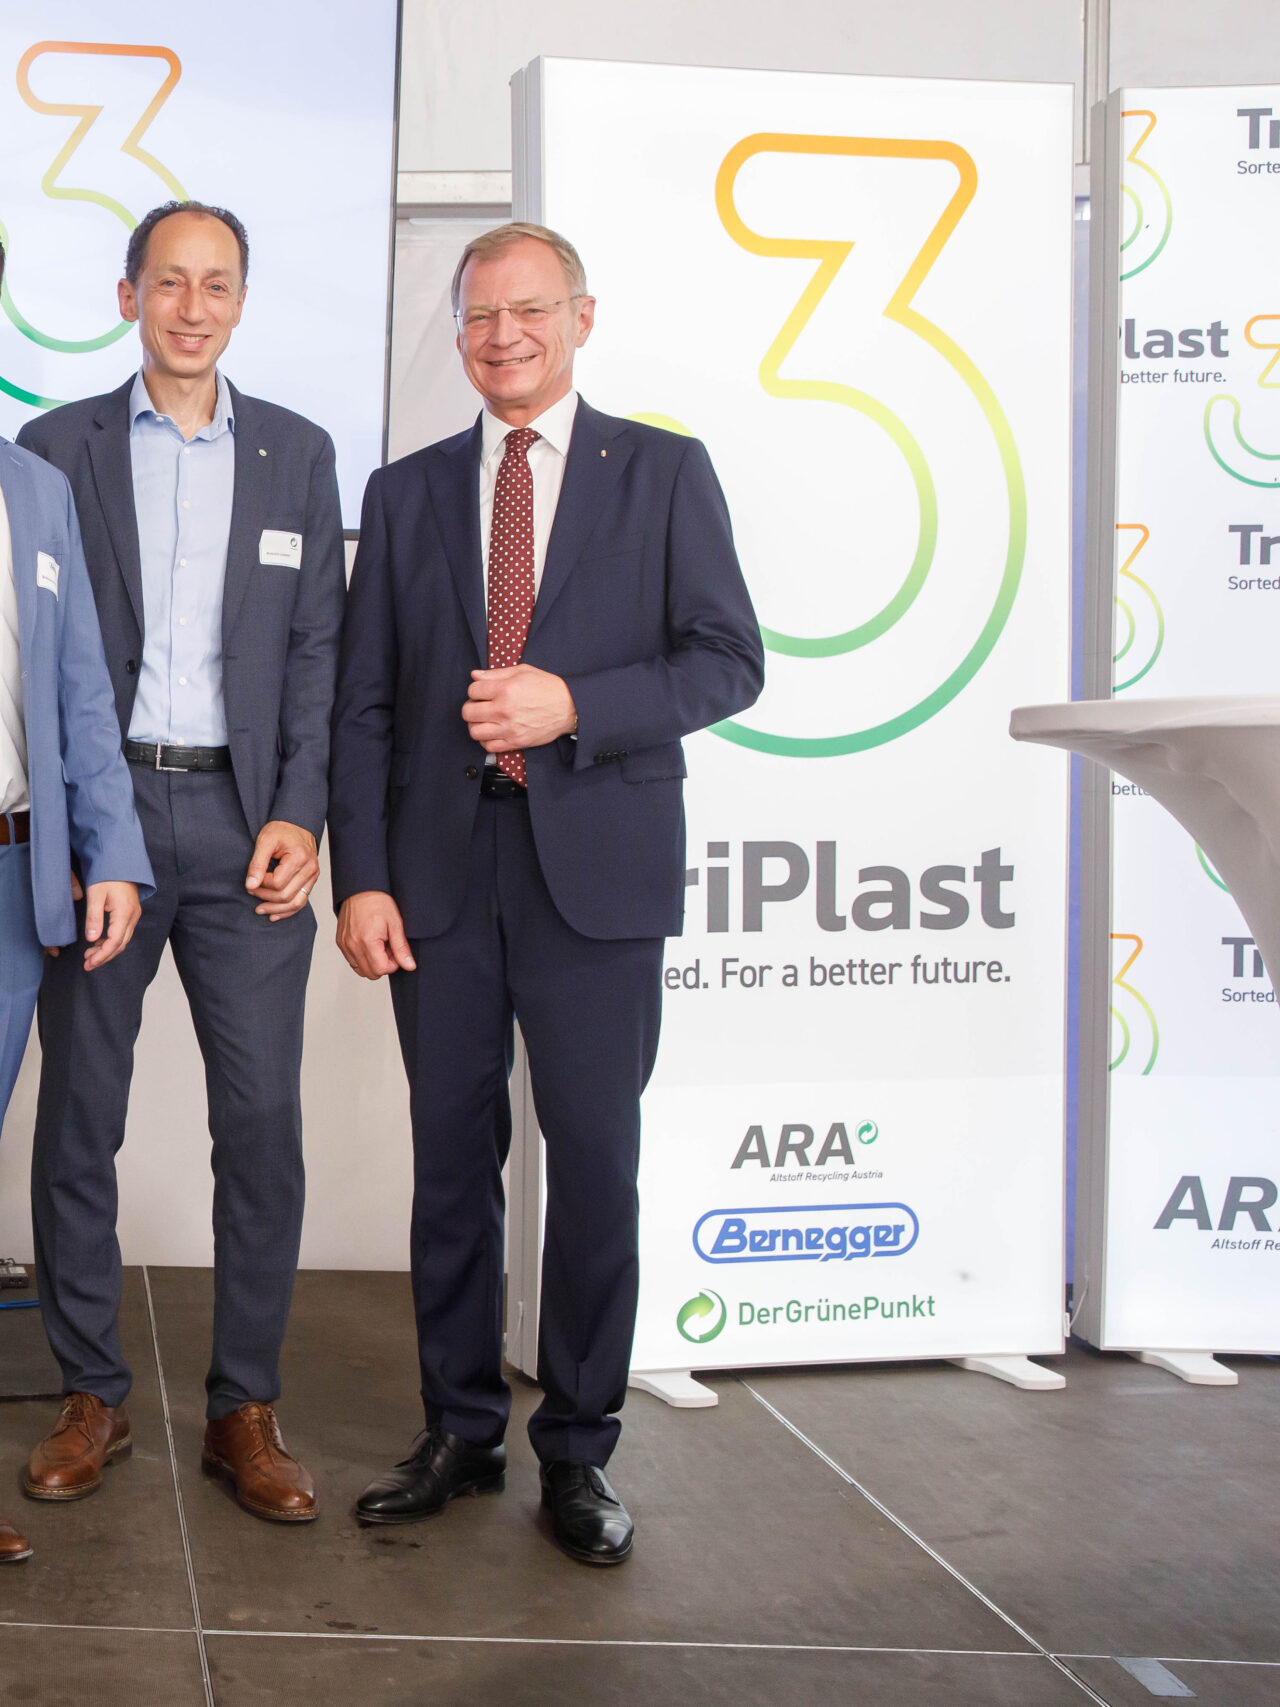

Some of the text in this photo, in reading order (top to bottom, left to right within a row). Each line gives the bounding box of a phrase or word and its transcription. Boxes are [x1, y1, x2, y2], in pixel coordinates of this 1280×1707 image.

[1118, 318, 1230, 360] last
[1120, 369, 1227, 384] better future.
[1111, 780, 1151, 796] bett
[721, 957, 773, 989] For
[781, 963, 799, 987] a
[809, 956, 903, 987] better
[911, 954, 1012, 984] future.
[730, 1122, 856, 1169] ARA
[769, 1169, 884, 1183] Altstoff Recycling Austria
[1152, 1175, 1280, 1232] AR
[709, 1217, 906, 1262] Bernegger
[1210, 1238, 1262, 1251] Altstoff
[738, 1294, 936, 1326] DerGrünePunkt
